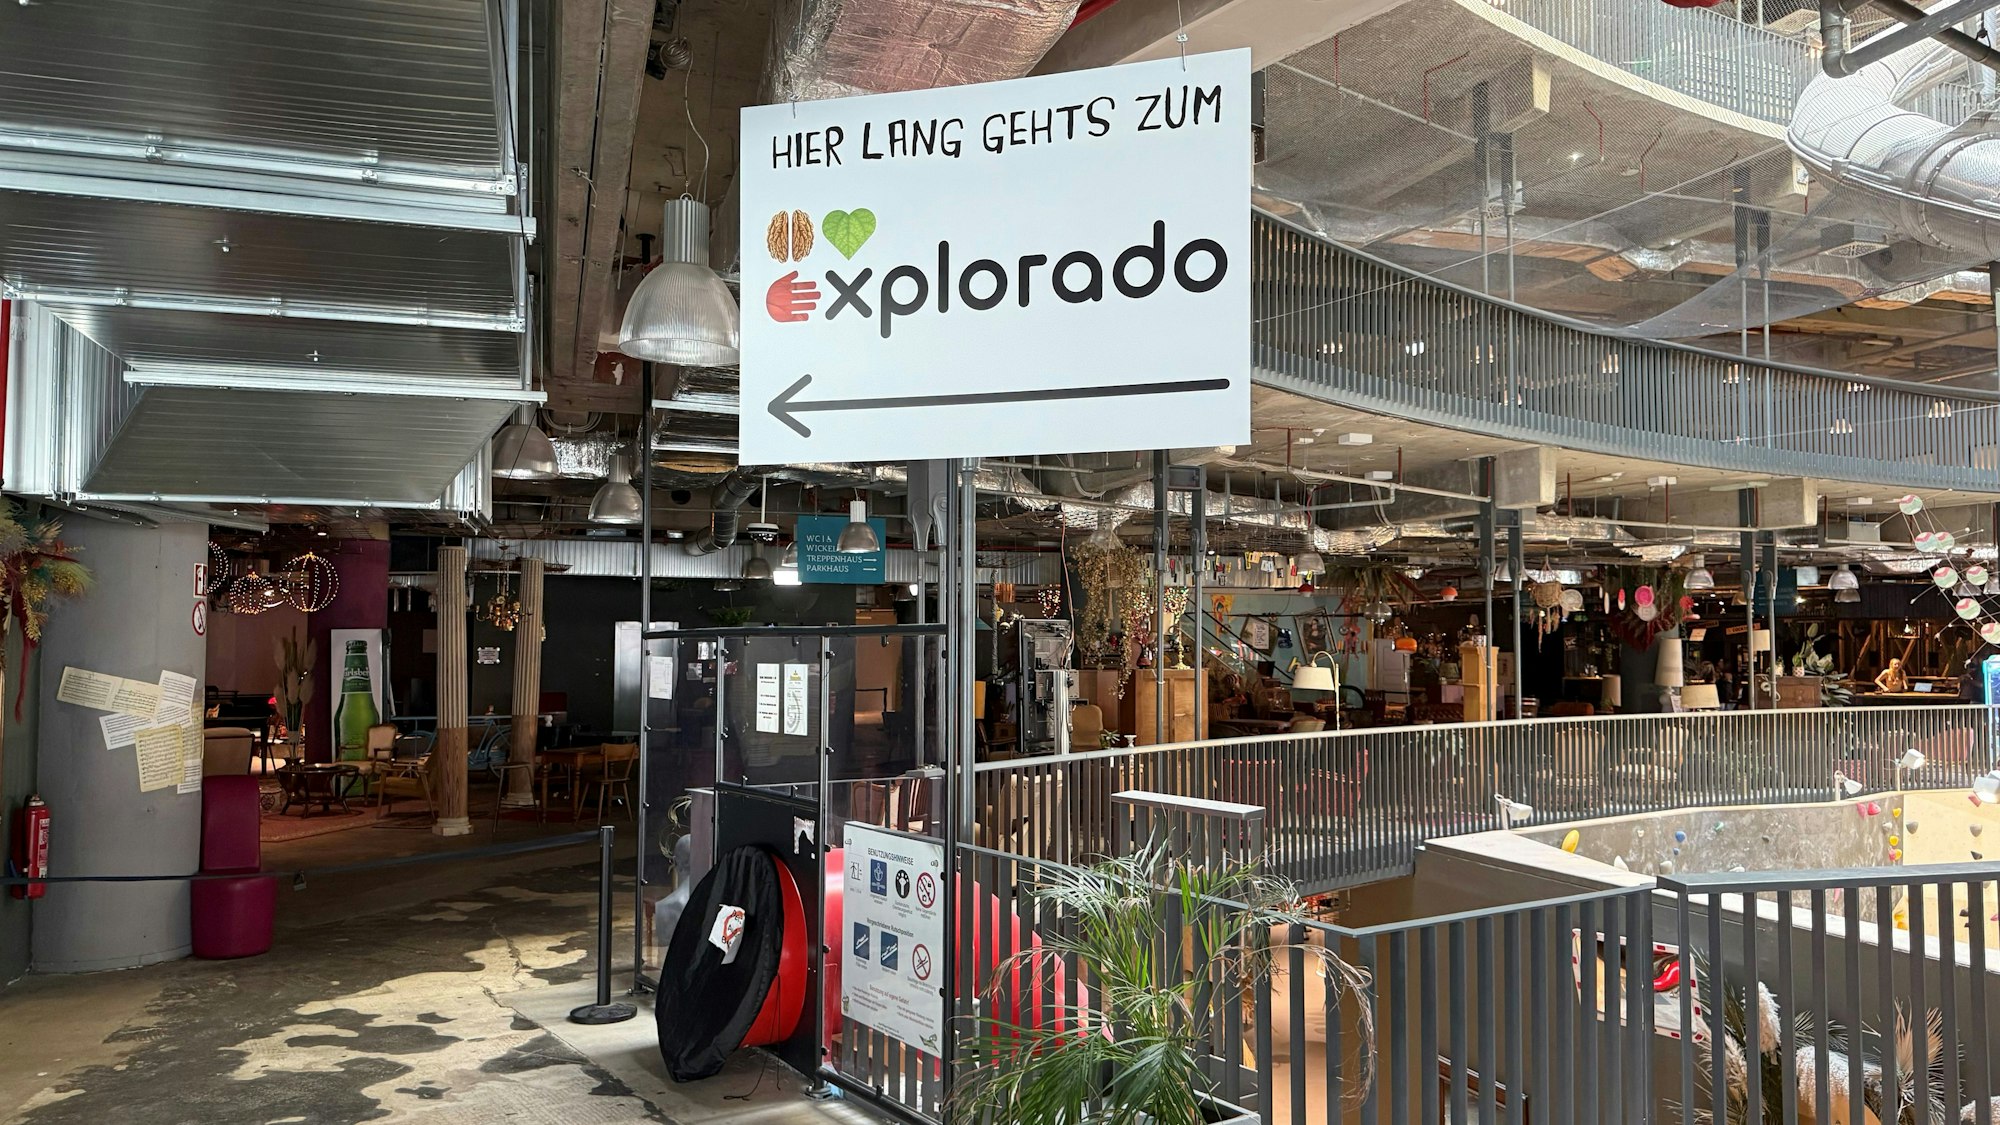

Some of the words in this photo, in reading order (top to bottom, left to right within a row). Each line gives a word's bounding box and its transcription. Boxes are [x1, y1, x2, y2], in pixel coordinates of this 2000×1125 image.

[771, 126, 845, 169] HIER
[862, 118, 965, 160] LANG
[982, 96, 1115, 154] GEHTS
[1135, 84, 1223, 132] ZUM
[806, 535, 820, 543] WC
[806, 545, 837, 553] WICKEL
[806, 554, 863, 563] TREPPENHAUS
[806, 564, 849, 573] PARKHAUS
[868, 848, 914, 866] BENUTZUNGSHINWEISE
